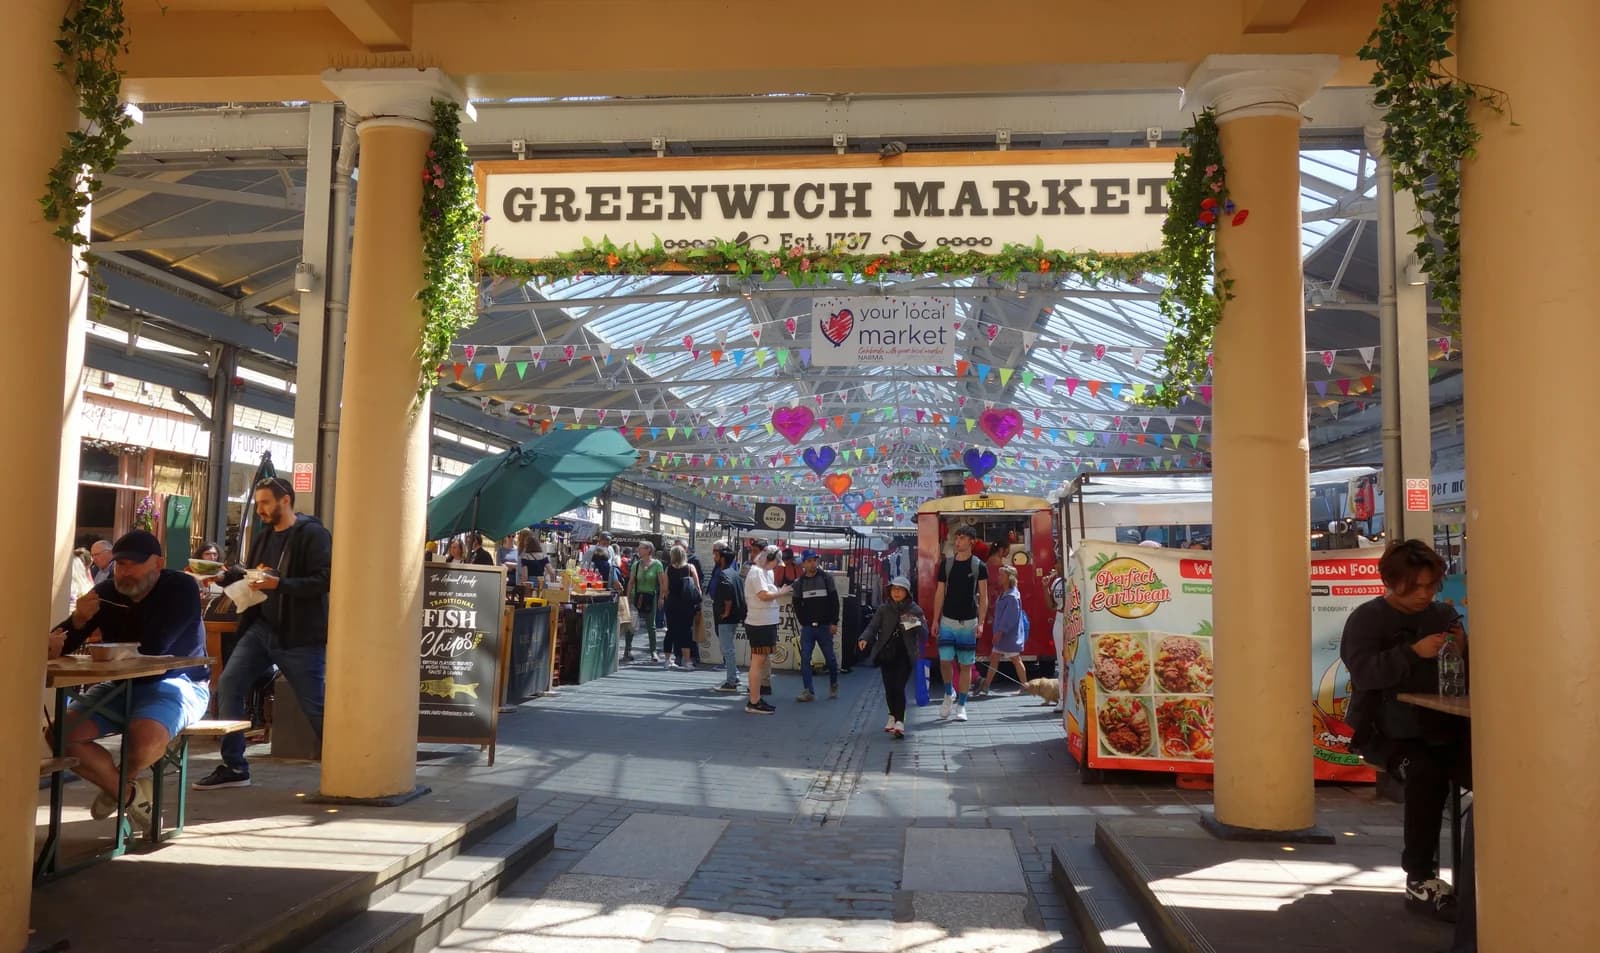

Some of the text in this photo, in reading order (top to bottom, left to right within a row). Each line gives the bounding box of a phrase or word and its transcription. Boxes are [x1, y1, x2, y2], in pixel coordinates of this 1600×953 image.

[502, 178, 1173, 223] GREENWICH MARKET
[825, 231, 871, 250] 1737
[860, 305, 945, 322] your local
[859, 324, 947, 346] market
[1432, 482, 1447, 497] per
[1096, 567, 1156, 588] Perfect
[1311, 565, 1346, 575] BBEAN
[430, 598, 475, 609] TRADITIONAL
[1089, 588, 1172, 612] Caribbean
[423, 608, 478, 629] FISH
[420, 631, 473, 657] Chips
